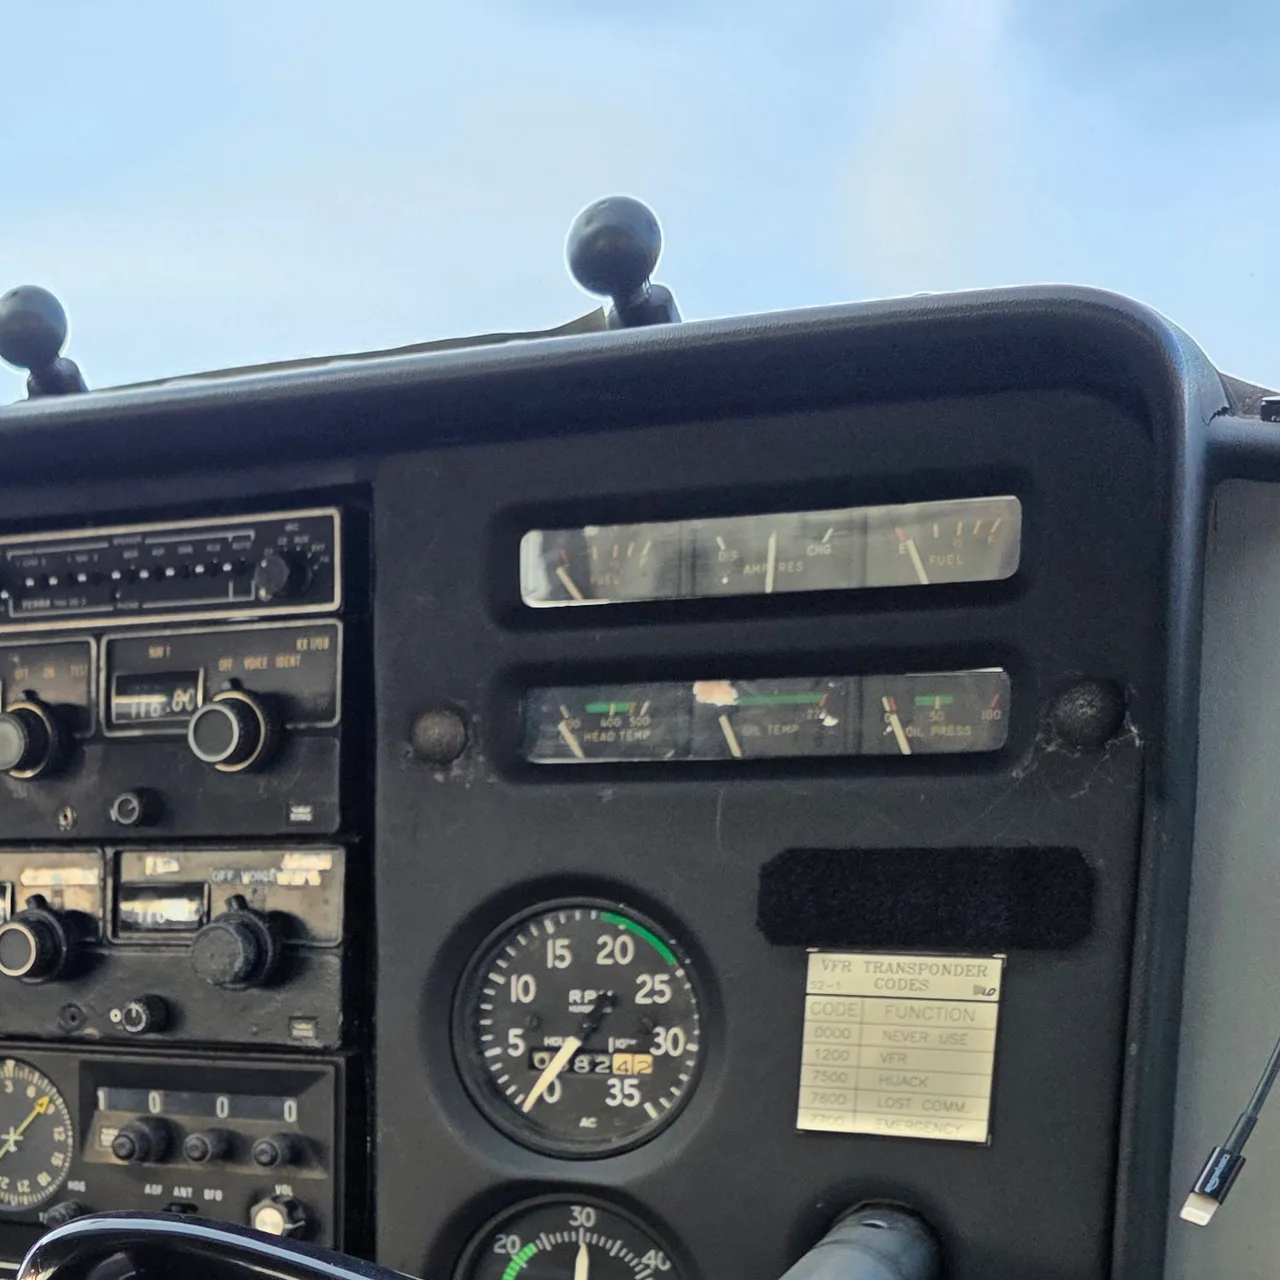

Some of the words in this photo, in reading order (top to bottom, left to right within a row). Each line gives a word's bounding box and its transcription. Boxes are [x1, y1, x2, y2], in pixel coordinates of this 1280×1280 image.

[807, 545, 831, 556] CHG
[899, 543, 907, 554] E
[928, 553, 963, 567] FUEL
[276, 654, 301, 669] IDENT
[584, 731, 616, 743] HEAD
[620, 729, 650, 742] TEMP
[768, 725, 799, 735] TEMP
[906, 726, 923, 738] OIL
[931, 724, 972, 737] PRESS
[546, 938, 573, 969] 15
[596, 934, 636, 966] 20
[821, 960, 852, 973] VFR
[863, 960, 989, 979] TRANSPONDER
[510, 973, 537, 1004] 10
[635, 973, 673, 1005] 25
[874, 977, 930, 992] CODES
[809, 1001, 860, 1018] CODE
[884, 1003, 977, 1023] FUNCTION
[507, 1028, 526, 1057] 5
[649, 1026, 686, 1057] 30
[882, 1030, 929, 1043] NEVER
[938, 1032, 969, 1046] USE
[814, 1049, 850, 1062] 1200
[880, 1052, 908, 1065] VFR
[812, 1070, 848, 1083] 7500
[878, 1075, 929, 1089] HIJACK
[605, 1078, 641, 1107] 35
[148, 1091, 161, 1114] 0
[216, 1096, 229, 1118] 0
[284, 1100, 297, 1122] 0
[877, 1096, 912, 1109] LOST
[579, 1117, 598, 1128] AC
[875, 1118, 963, 1134] EMERGENCY
[173, 1186, 194, 1199] ANT
[274, 1183, 293, 1198] VOL
[569, 1206, 596, 1227] 30
[493, 1234, 520, 1255] 20
[641, 1249, 671, 1272] 40
